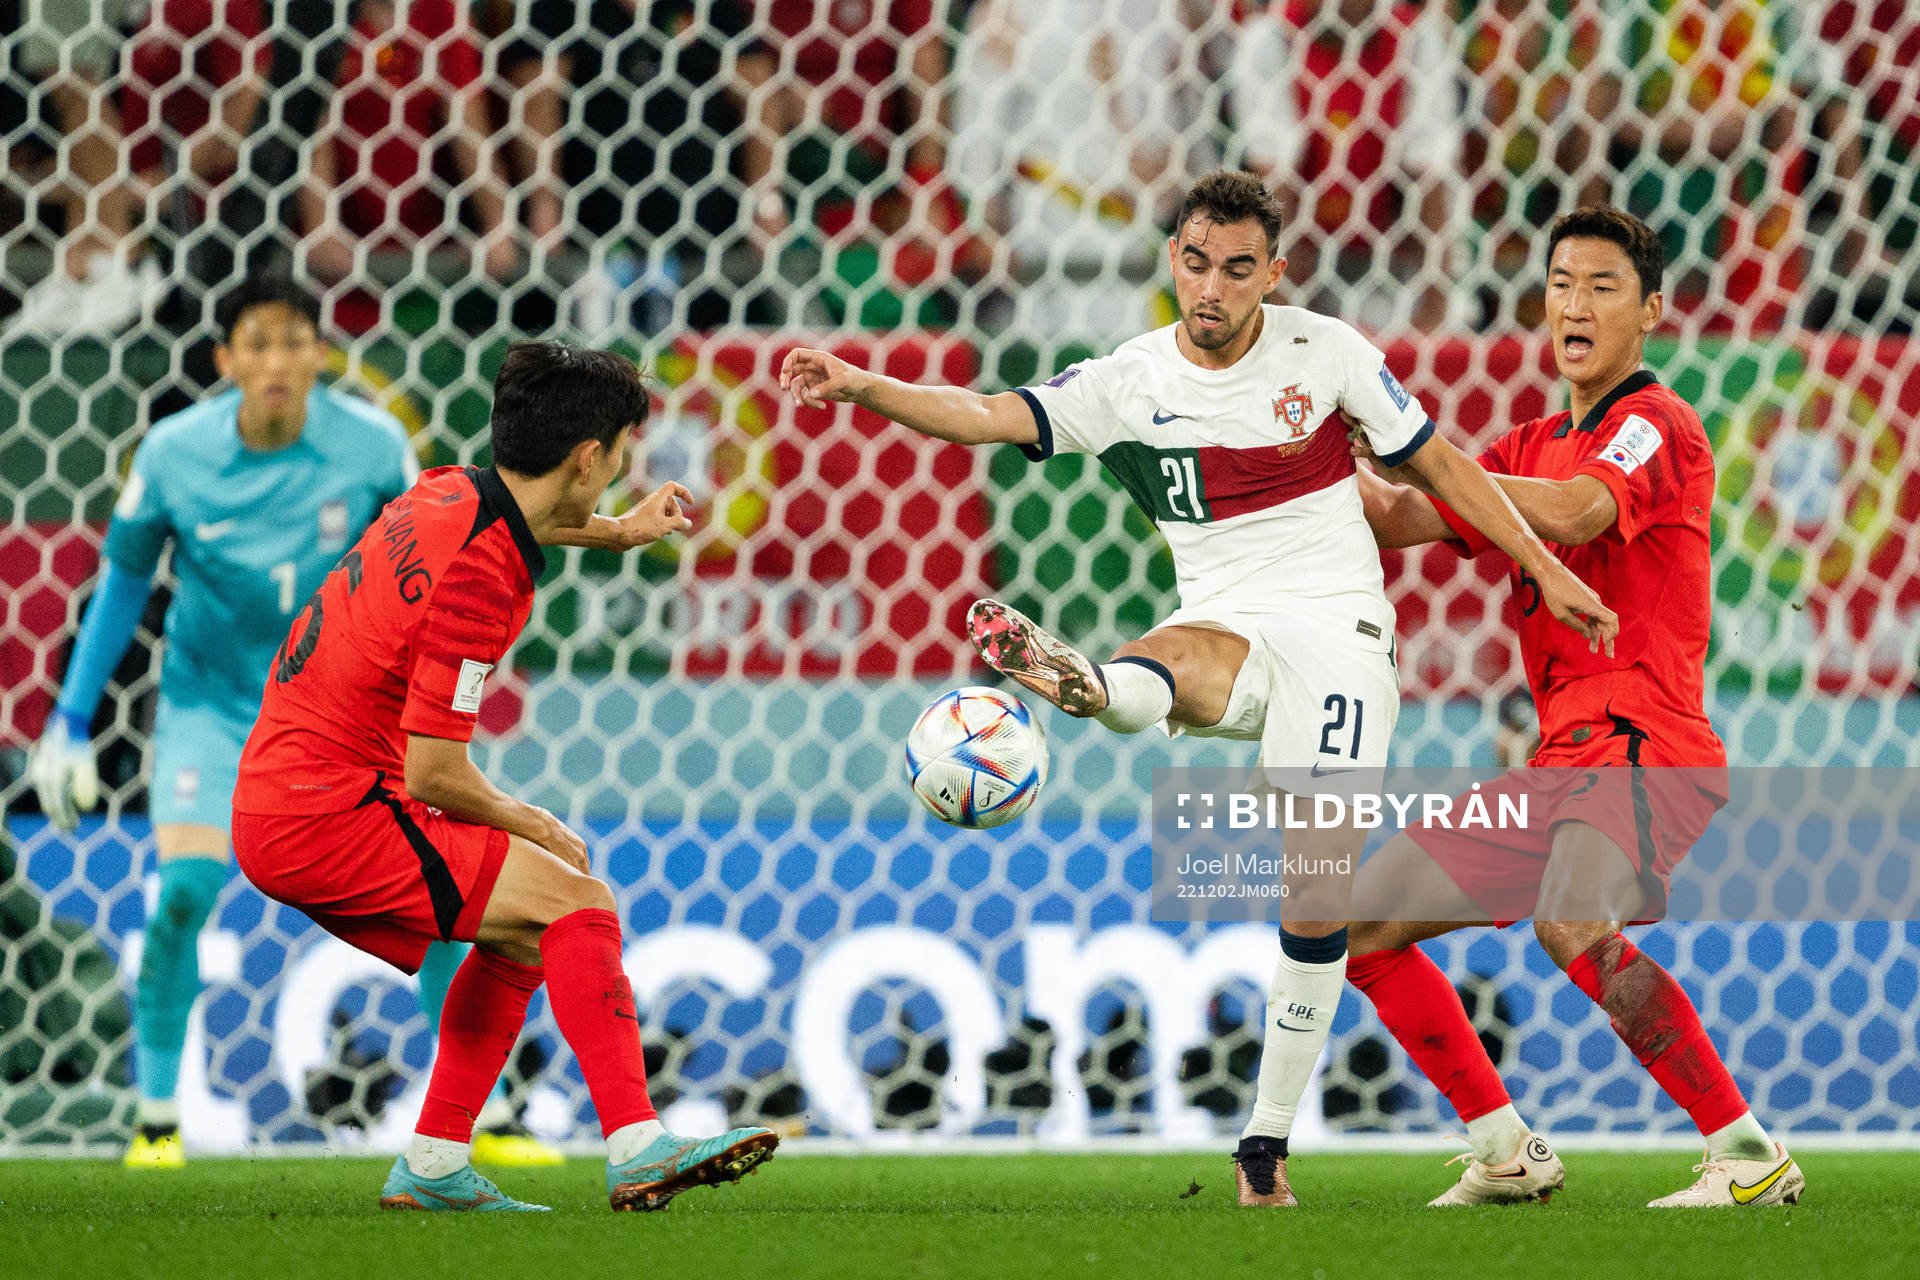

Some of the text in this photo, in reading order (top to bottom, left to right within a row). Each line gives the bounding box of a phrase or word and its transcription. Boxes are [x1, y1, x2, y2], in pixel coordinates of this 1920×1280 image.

[1160, 457, 1205, 519] 21
[383, 500, 432, 605] WANG
[270, 563, 296, 614] 1
[1520, 565, 1540, 617] 5
[1319, 693, 1363, 760] 21
